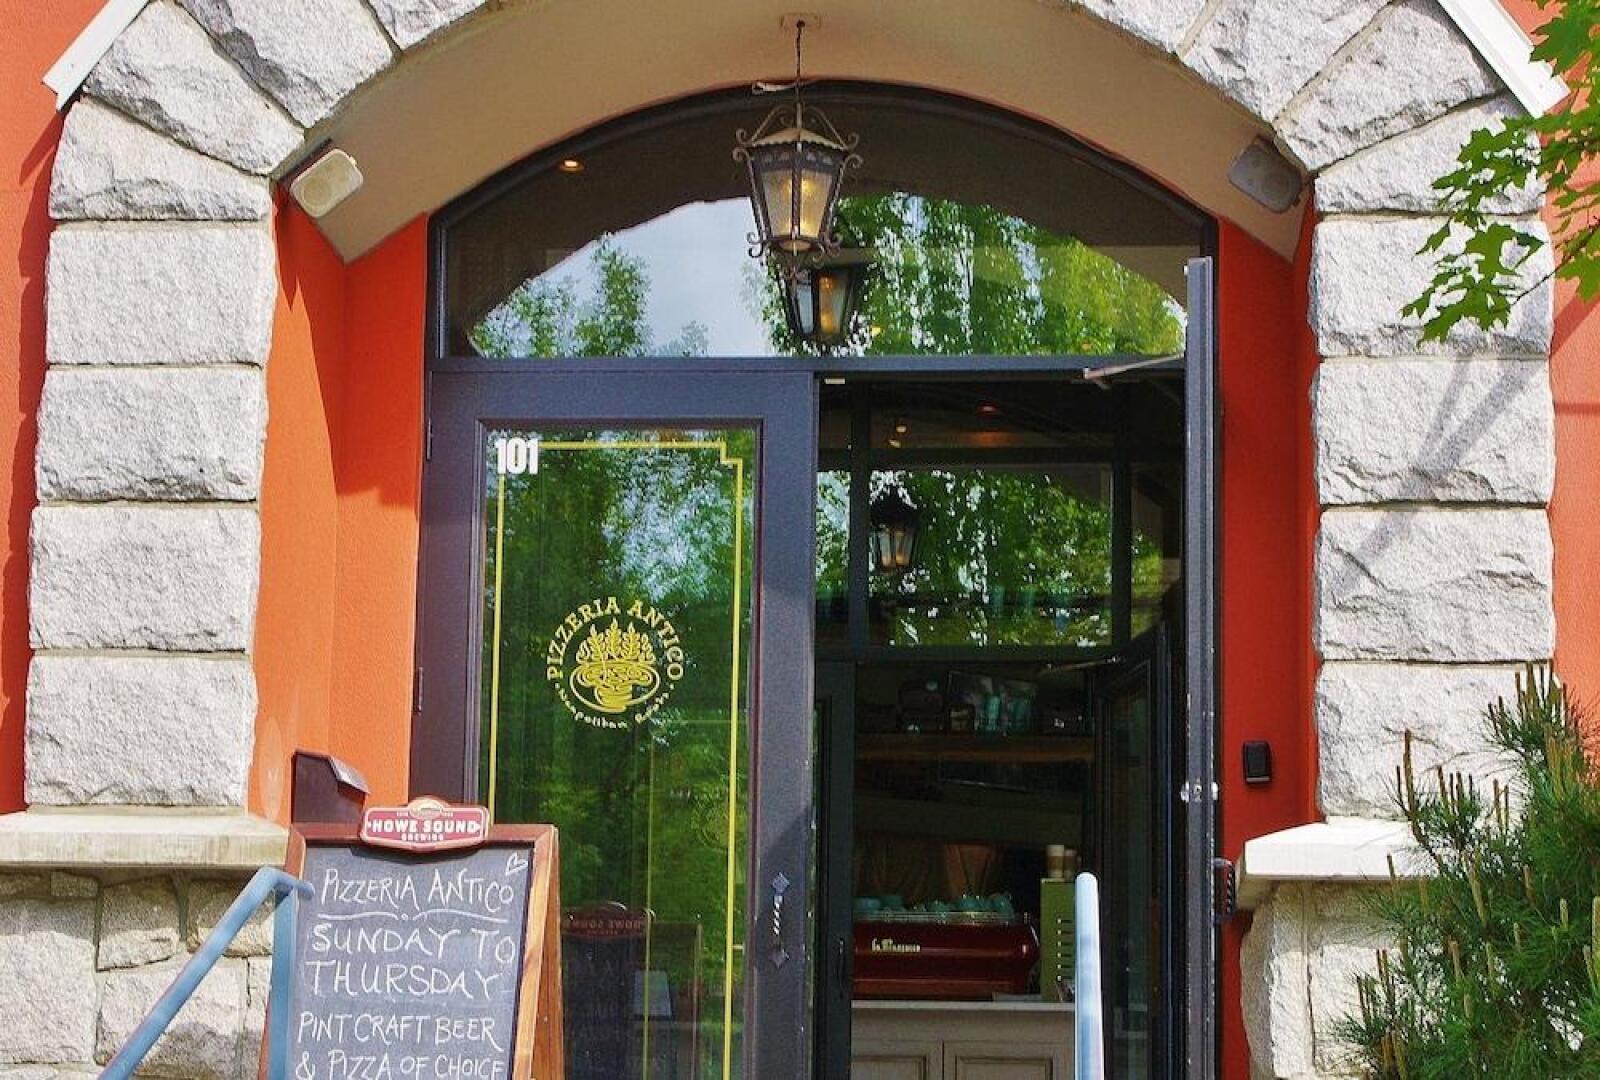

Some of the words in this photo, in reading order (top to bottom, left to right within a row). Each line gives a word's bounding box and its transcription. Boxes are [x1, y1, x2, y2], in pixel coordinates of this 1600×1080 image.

[494, 438, 538, 474] 101
[546, 596, 621, 680] PIZZERIA
[627, 600, 684, 680] ANTICO
[372, 819, 418, 833] HOWE
[423, 819, 477, 833] SOUND
[321, 868, 420, 911] PIZZERIA
[428, 868, 514, 913] ANTICO
[311, 922, 461, 960] SUNDAY
[471, 927, 516, 964] TO
[303, 959, 502, 999] THURSDAY
[297, 1011, 352, 1043] PINT
[354, 1013, 431, 1046] CRAFT
[434, 1016, 504, 1052] BEER
[295, 1050, 316, 1080] &
[327, 1049, 393, 1080] PIZZA
[399, 1056, 430, 1080] OF
